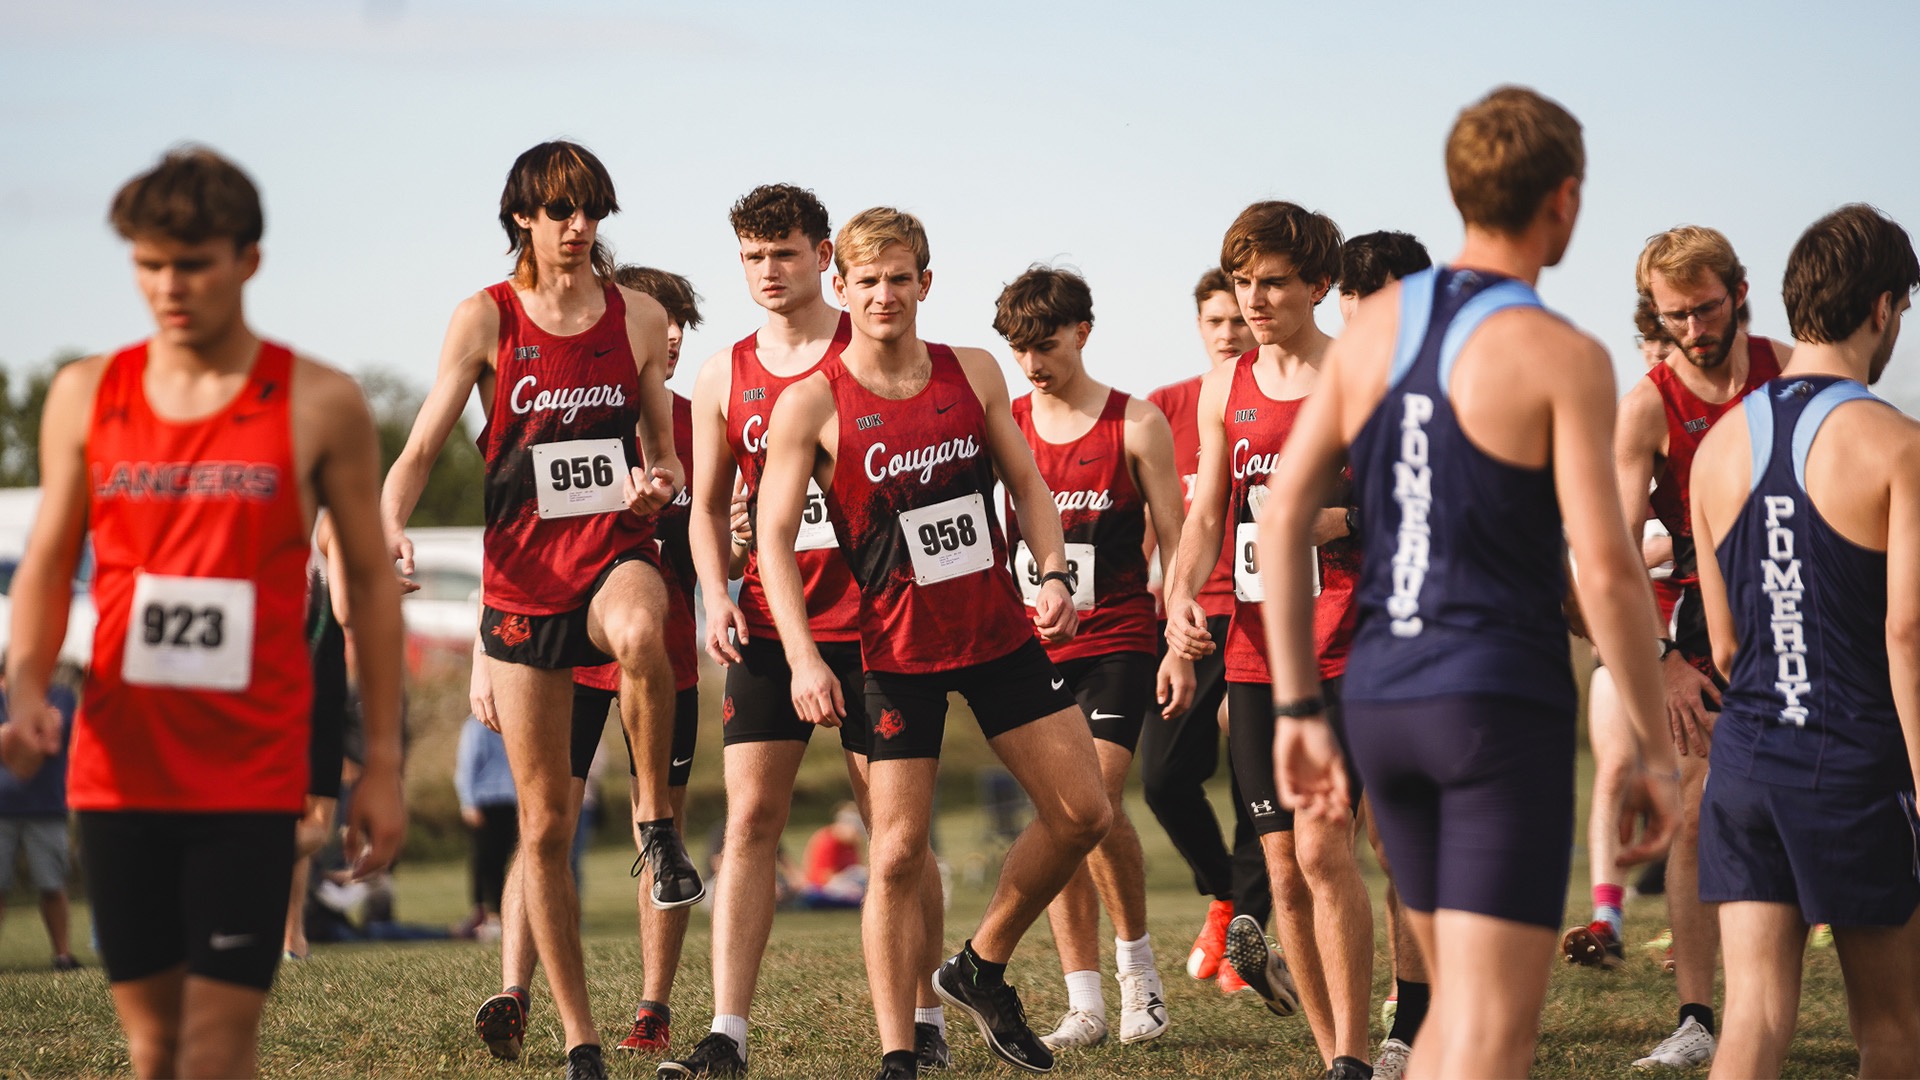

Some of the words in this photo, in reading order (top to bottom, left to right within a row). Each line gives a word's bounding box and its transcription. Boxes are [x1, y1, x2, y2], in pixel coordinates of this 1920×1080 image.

[515, 345, 540, 360] IUK
[510, 375, 625, 424] Cougars
[743, 387, 765, 402] IUK
[856, 413, 883, 430] IUK
[1234, 408, 1257, 423] IUK
[550, 454, 614, 491] 956
[864, 434, 979, 484] Cougars
[90, 461, 279, 500] LANCERS
[918, 513, 978, 556] 958
[143, 603, 226, 648] 923
